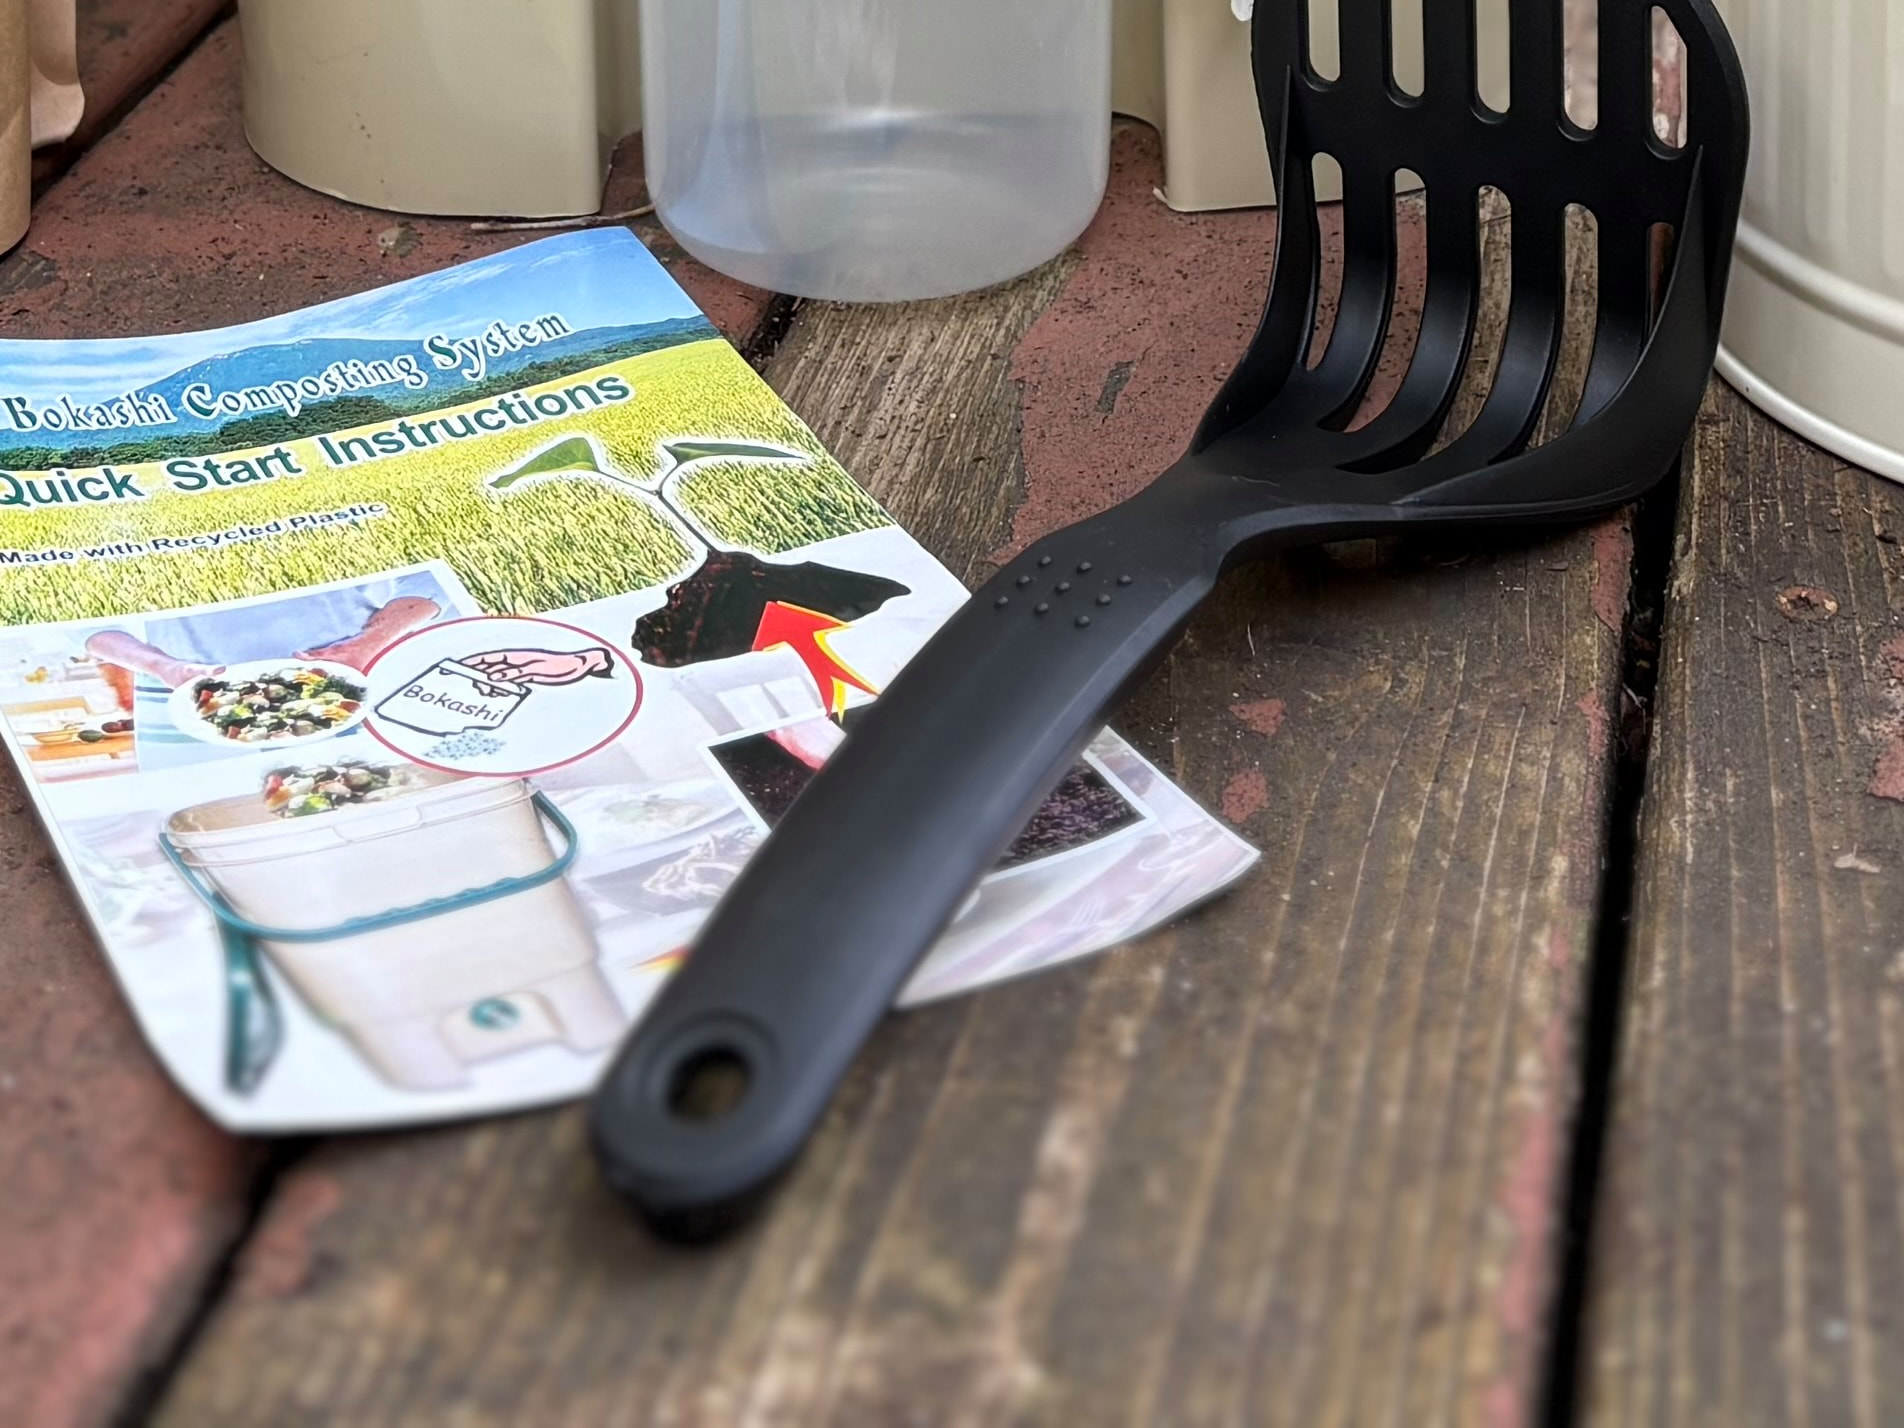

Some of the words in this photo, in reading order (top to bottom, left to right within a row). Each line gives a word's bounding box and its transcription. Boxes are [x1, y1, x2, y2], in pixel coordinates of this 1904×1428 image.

[2, 393, 175, 430] Bokashi
[186, 361, 425, 413] Composting
[429, 314, 570, 378] System
[166, 444, 302, 492] Start
[318, 375, 630, 466] Instructions
[81, 539, 143, 559] with
[150, 520, 284, 552] Recycled
[289, 502, 386, 530] Plastic
[403, 684, 504, 722] Bokashi
